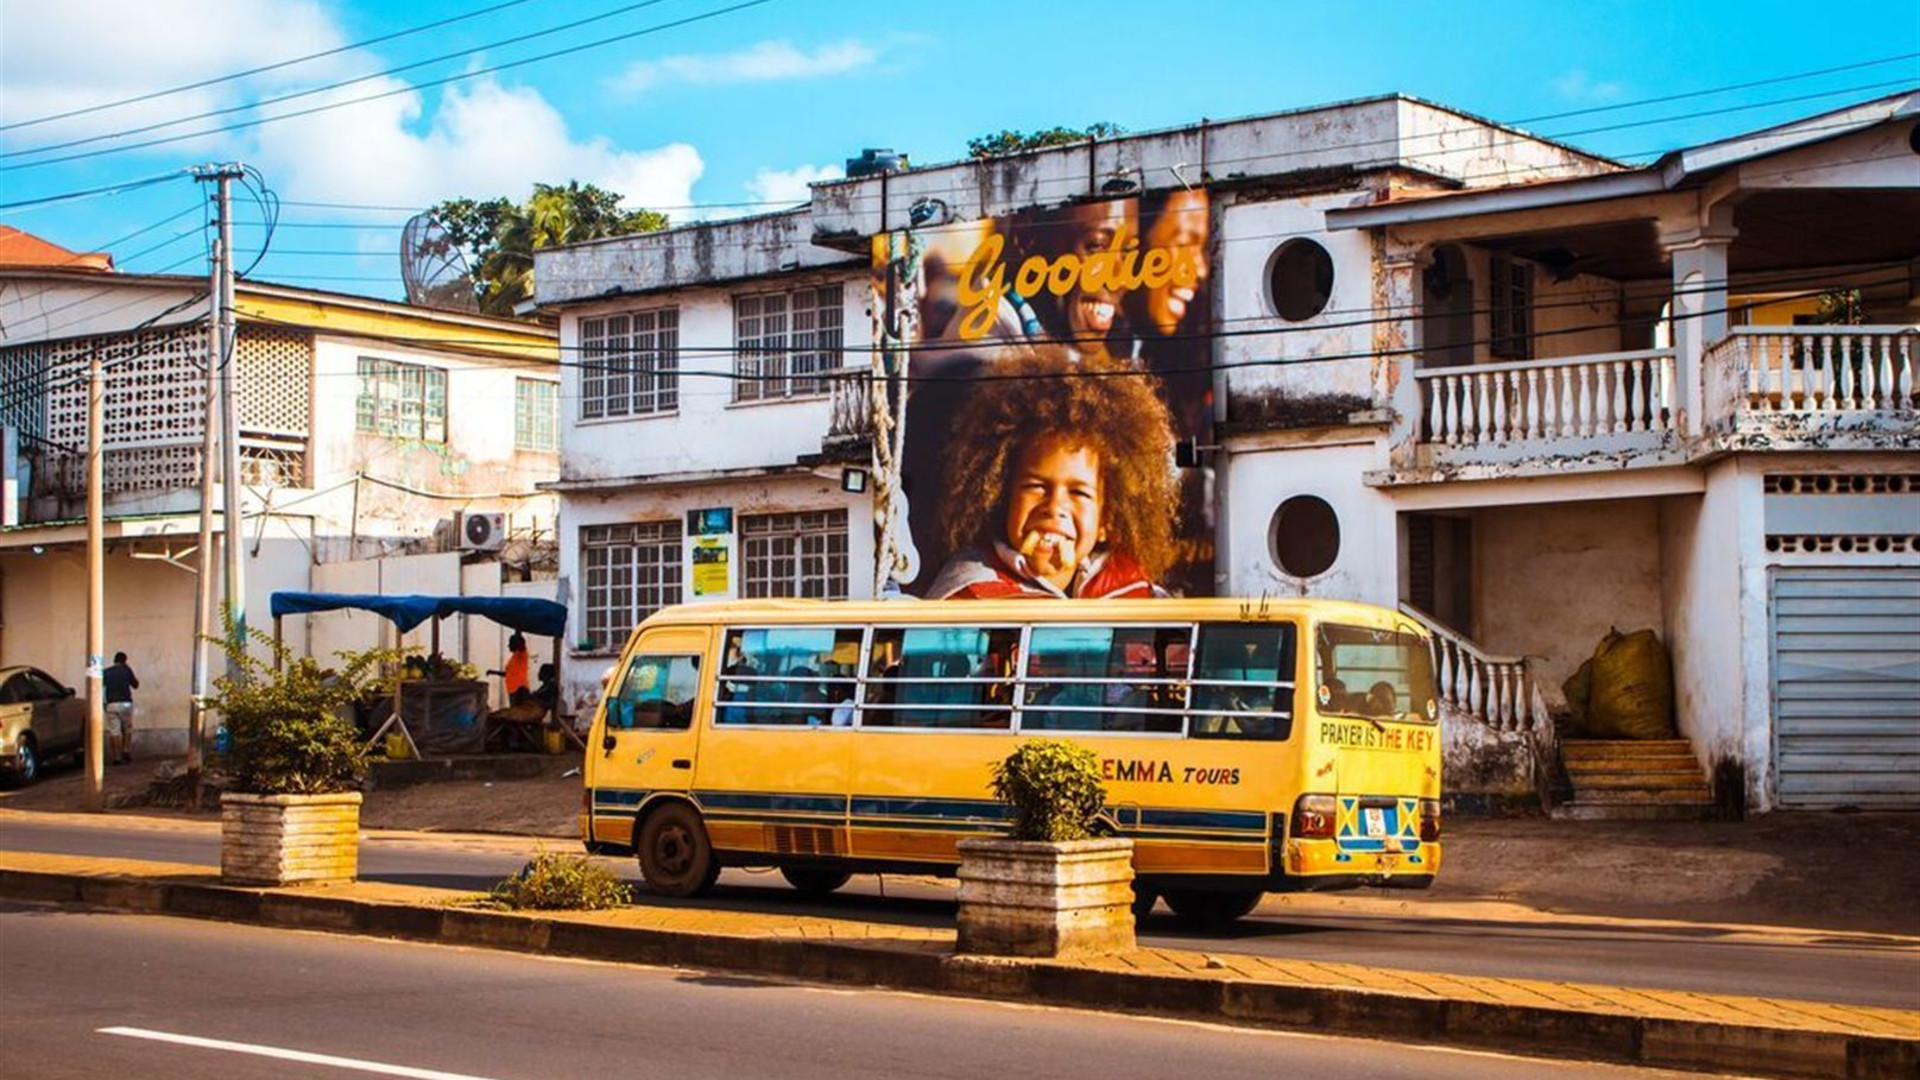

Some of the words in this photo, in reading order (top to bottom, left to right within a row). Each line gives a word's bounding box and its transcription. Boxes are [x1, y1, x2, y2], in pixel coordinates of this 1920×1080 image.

[957, 223, 1198, 341] Goodies
[1320, 722, 1362, 746] PRAYER
[1365, 726, 1376, 747] IS
[1378, 728, 1402, 749] THE
[1406, 730, 1435, 751] KEY
[1102, 759, 1174, 783] EMMA
[1183, 767, 1240, 784] TOURS
